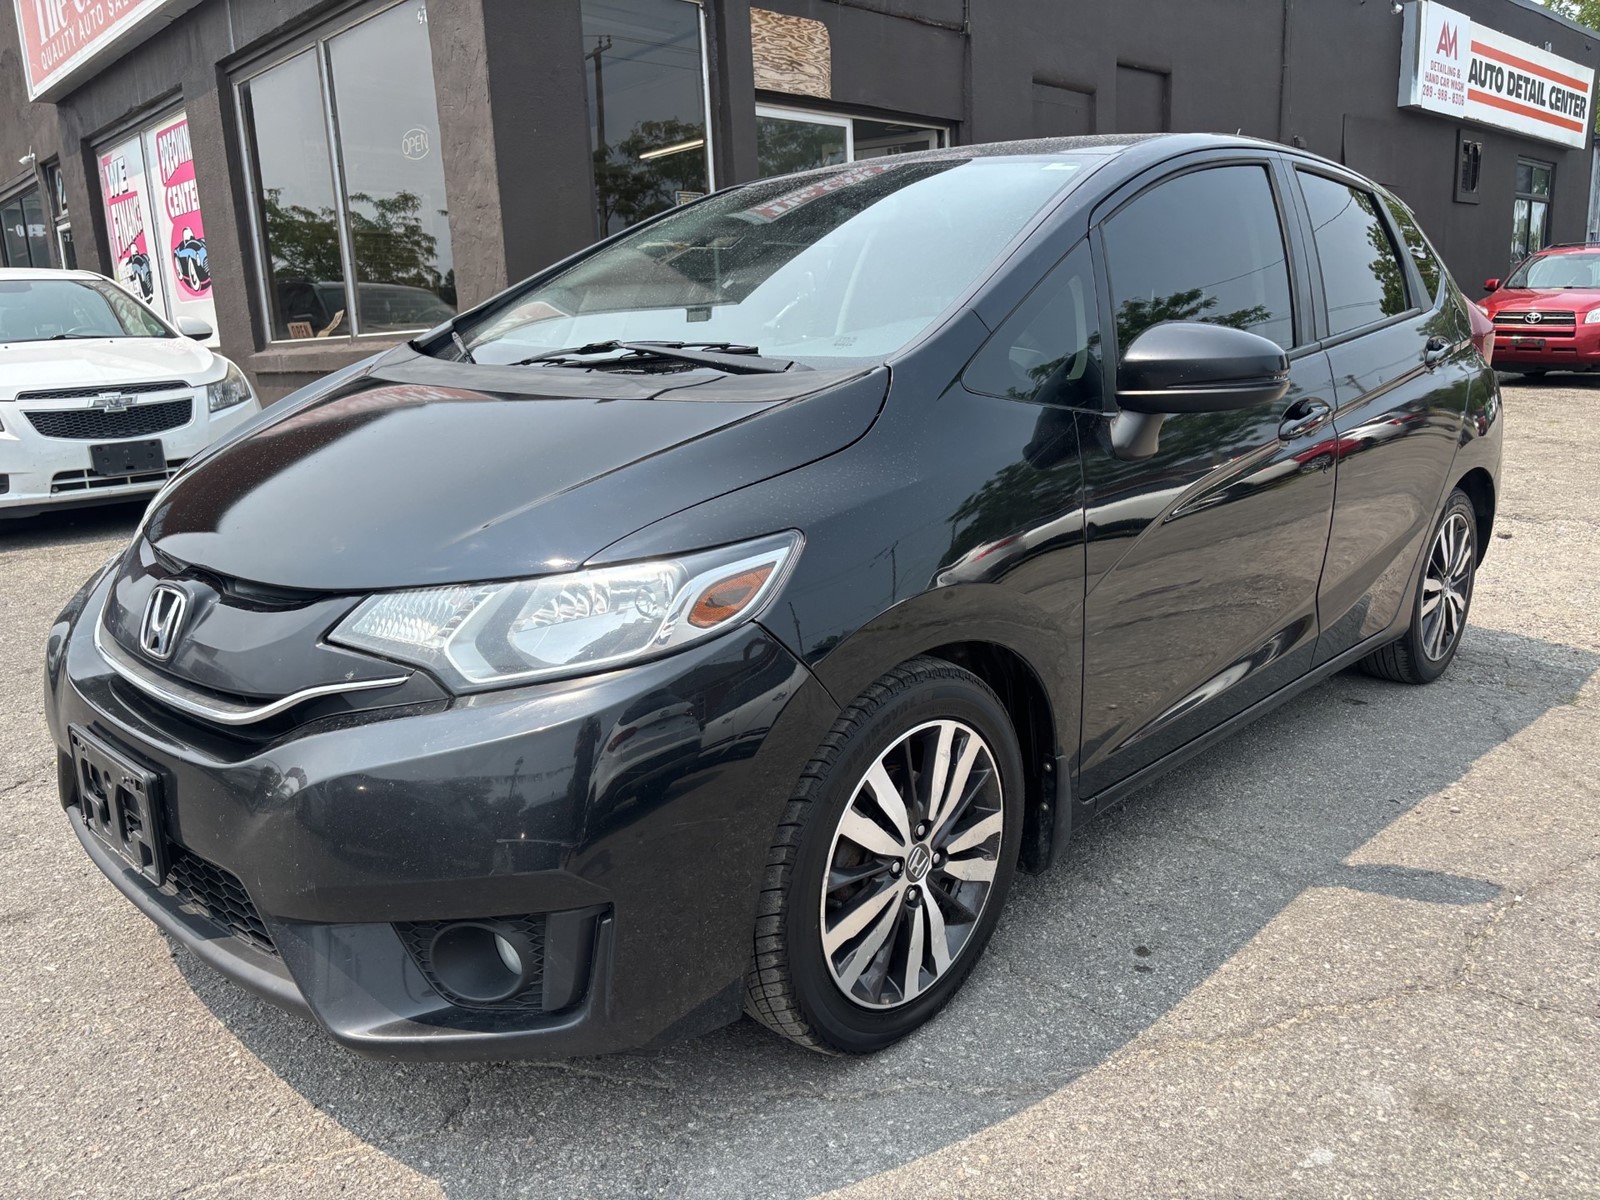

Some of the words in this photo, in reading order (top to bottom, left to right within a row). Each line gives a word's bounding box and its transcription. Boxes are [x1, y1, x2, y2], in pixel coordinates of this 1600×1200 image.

[41, 27, 77, 70] QUALITY
[78, 3, 105, 41] AUTO
[1425, 71, 1439, 85] HAND
[1440, 76, 1450, 88] CAR
[1450, 79, 1465, 92] WASH
[1430, 60, 1457, 78] DETAILING
[1456, 69, 1461, 79] &
[1468, 58, 1504, 93] AUTO
[1507, 71, 1546, 107] DETAIL
[1549, 85, 1587, 120] CENTER
[402, 133, 429, 156] OPEN
[104, 156, 129, 199] WE
[110, 195, 144, 259] FINANCE
[291, 324, 310, 337] OPEN
